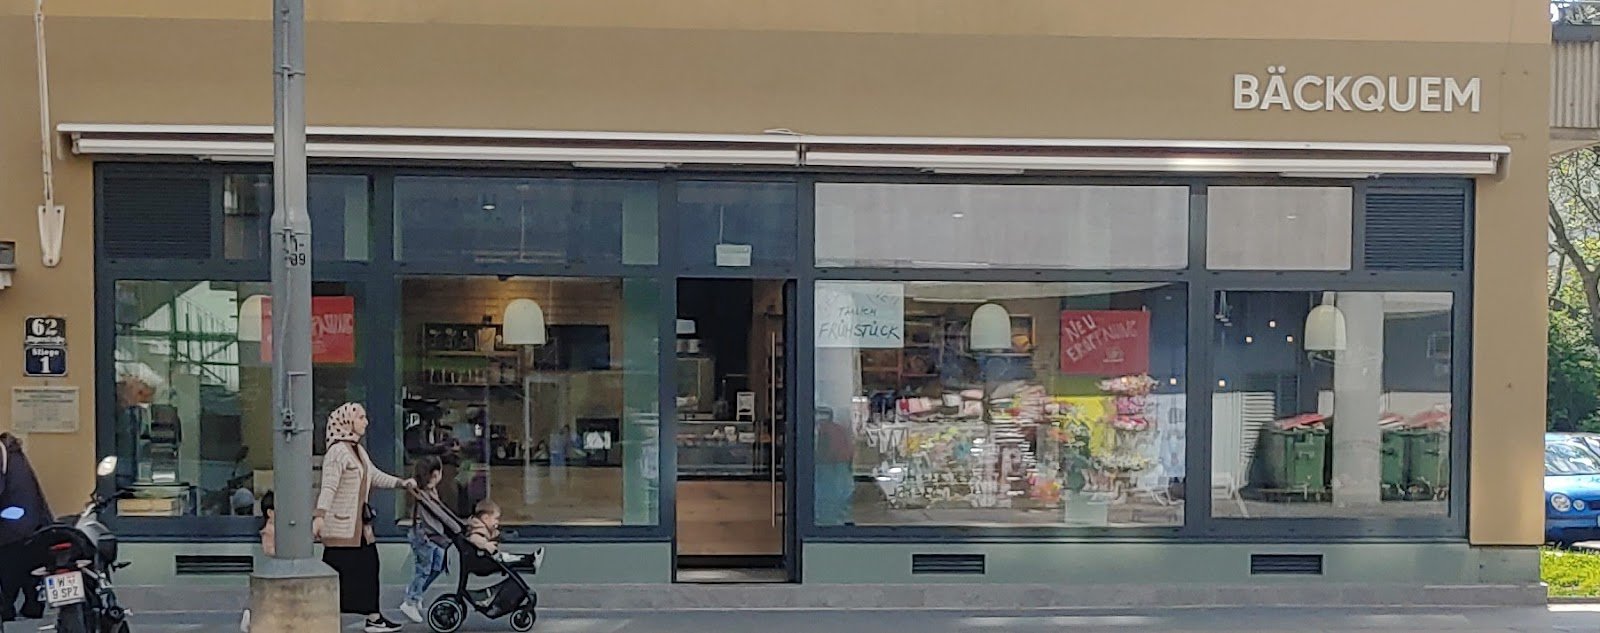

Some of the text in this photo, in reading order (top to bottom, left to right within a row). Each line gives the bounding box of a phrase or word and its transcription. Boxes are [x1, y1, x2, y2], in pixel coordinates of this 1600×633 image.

[1233, 65, 1481, 113] BÄCKQUEM
[31, 318, 58, 336] 62
[818, 319, 901, 340] FRÜHSTÜCK
[1065, 314, 1097, 341] NEU
[40, 356, 51, 373] 1
